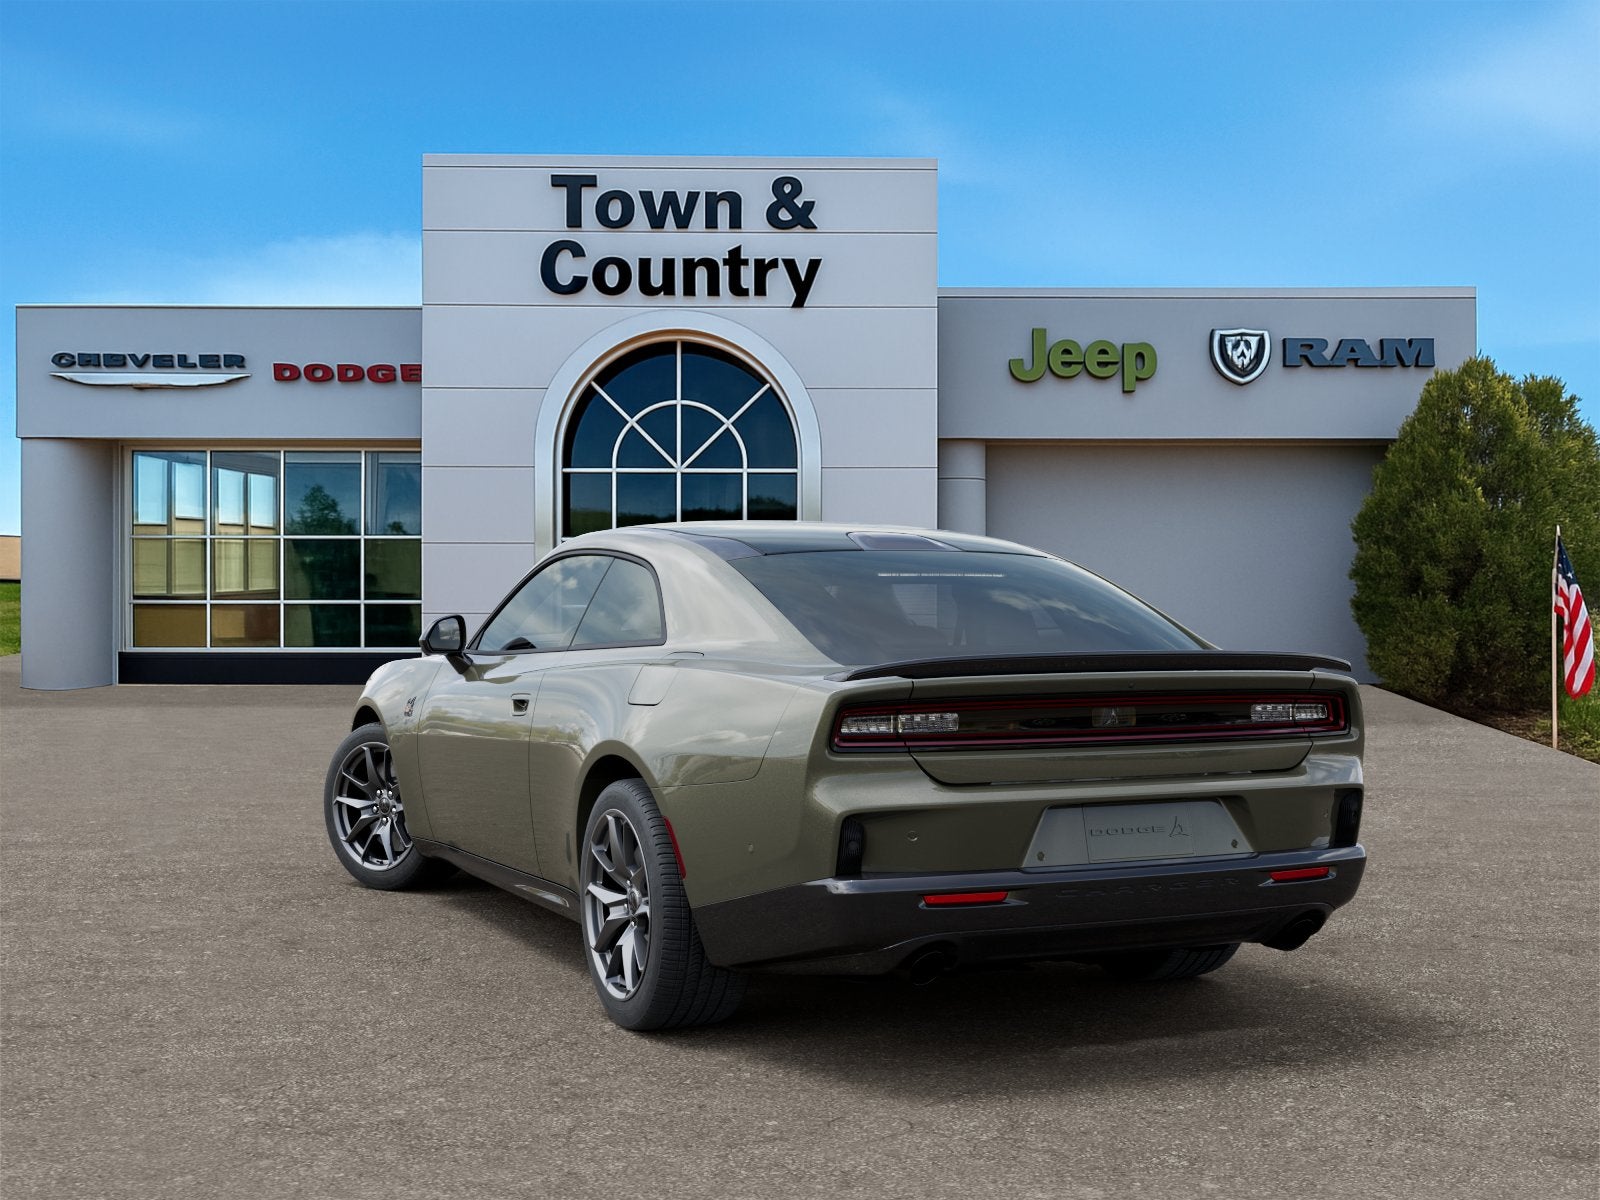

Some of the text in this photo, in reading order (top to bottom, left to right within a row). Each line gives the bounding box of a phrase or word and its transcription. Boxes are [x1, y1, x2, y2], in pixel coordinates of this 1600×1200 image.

[550, 174, 818, 230] Town &
[540, 239, 823, 308] Country
[272, 362, 422, 383] DODGE
[1009, 328, 1158, 393] Jeep
[1283, 338, 1435, 367] RAM
